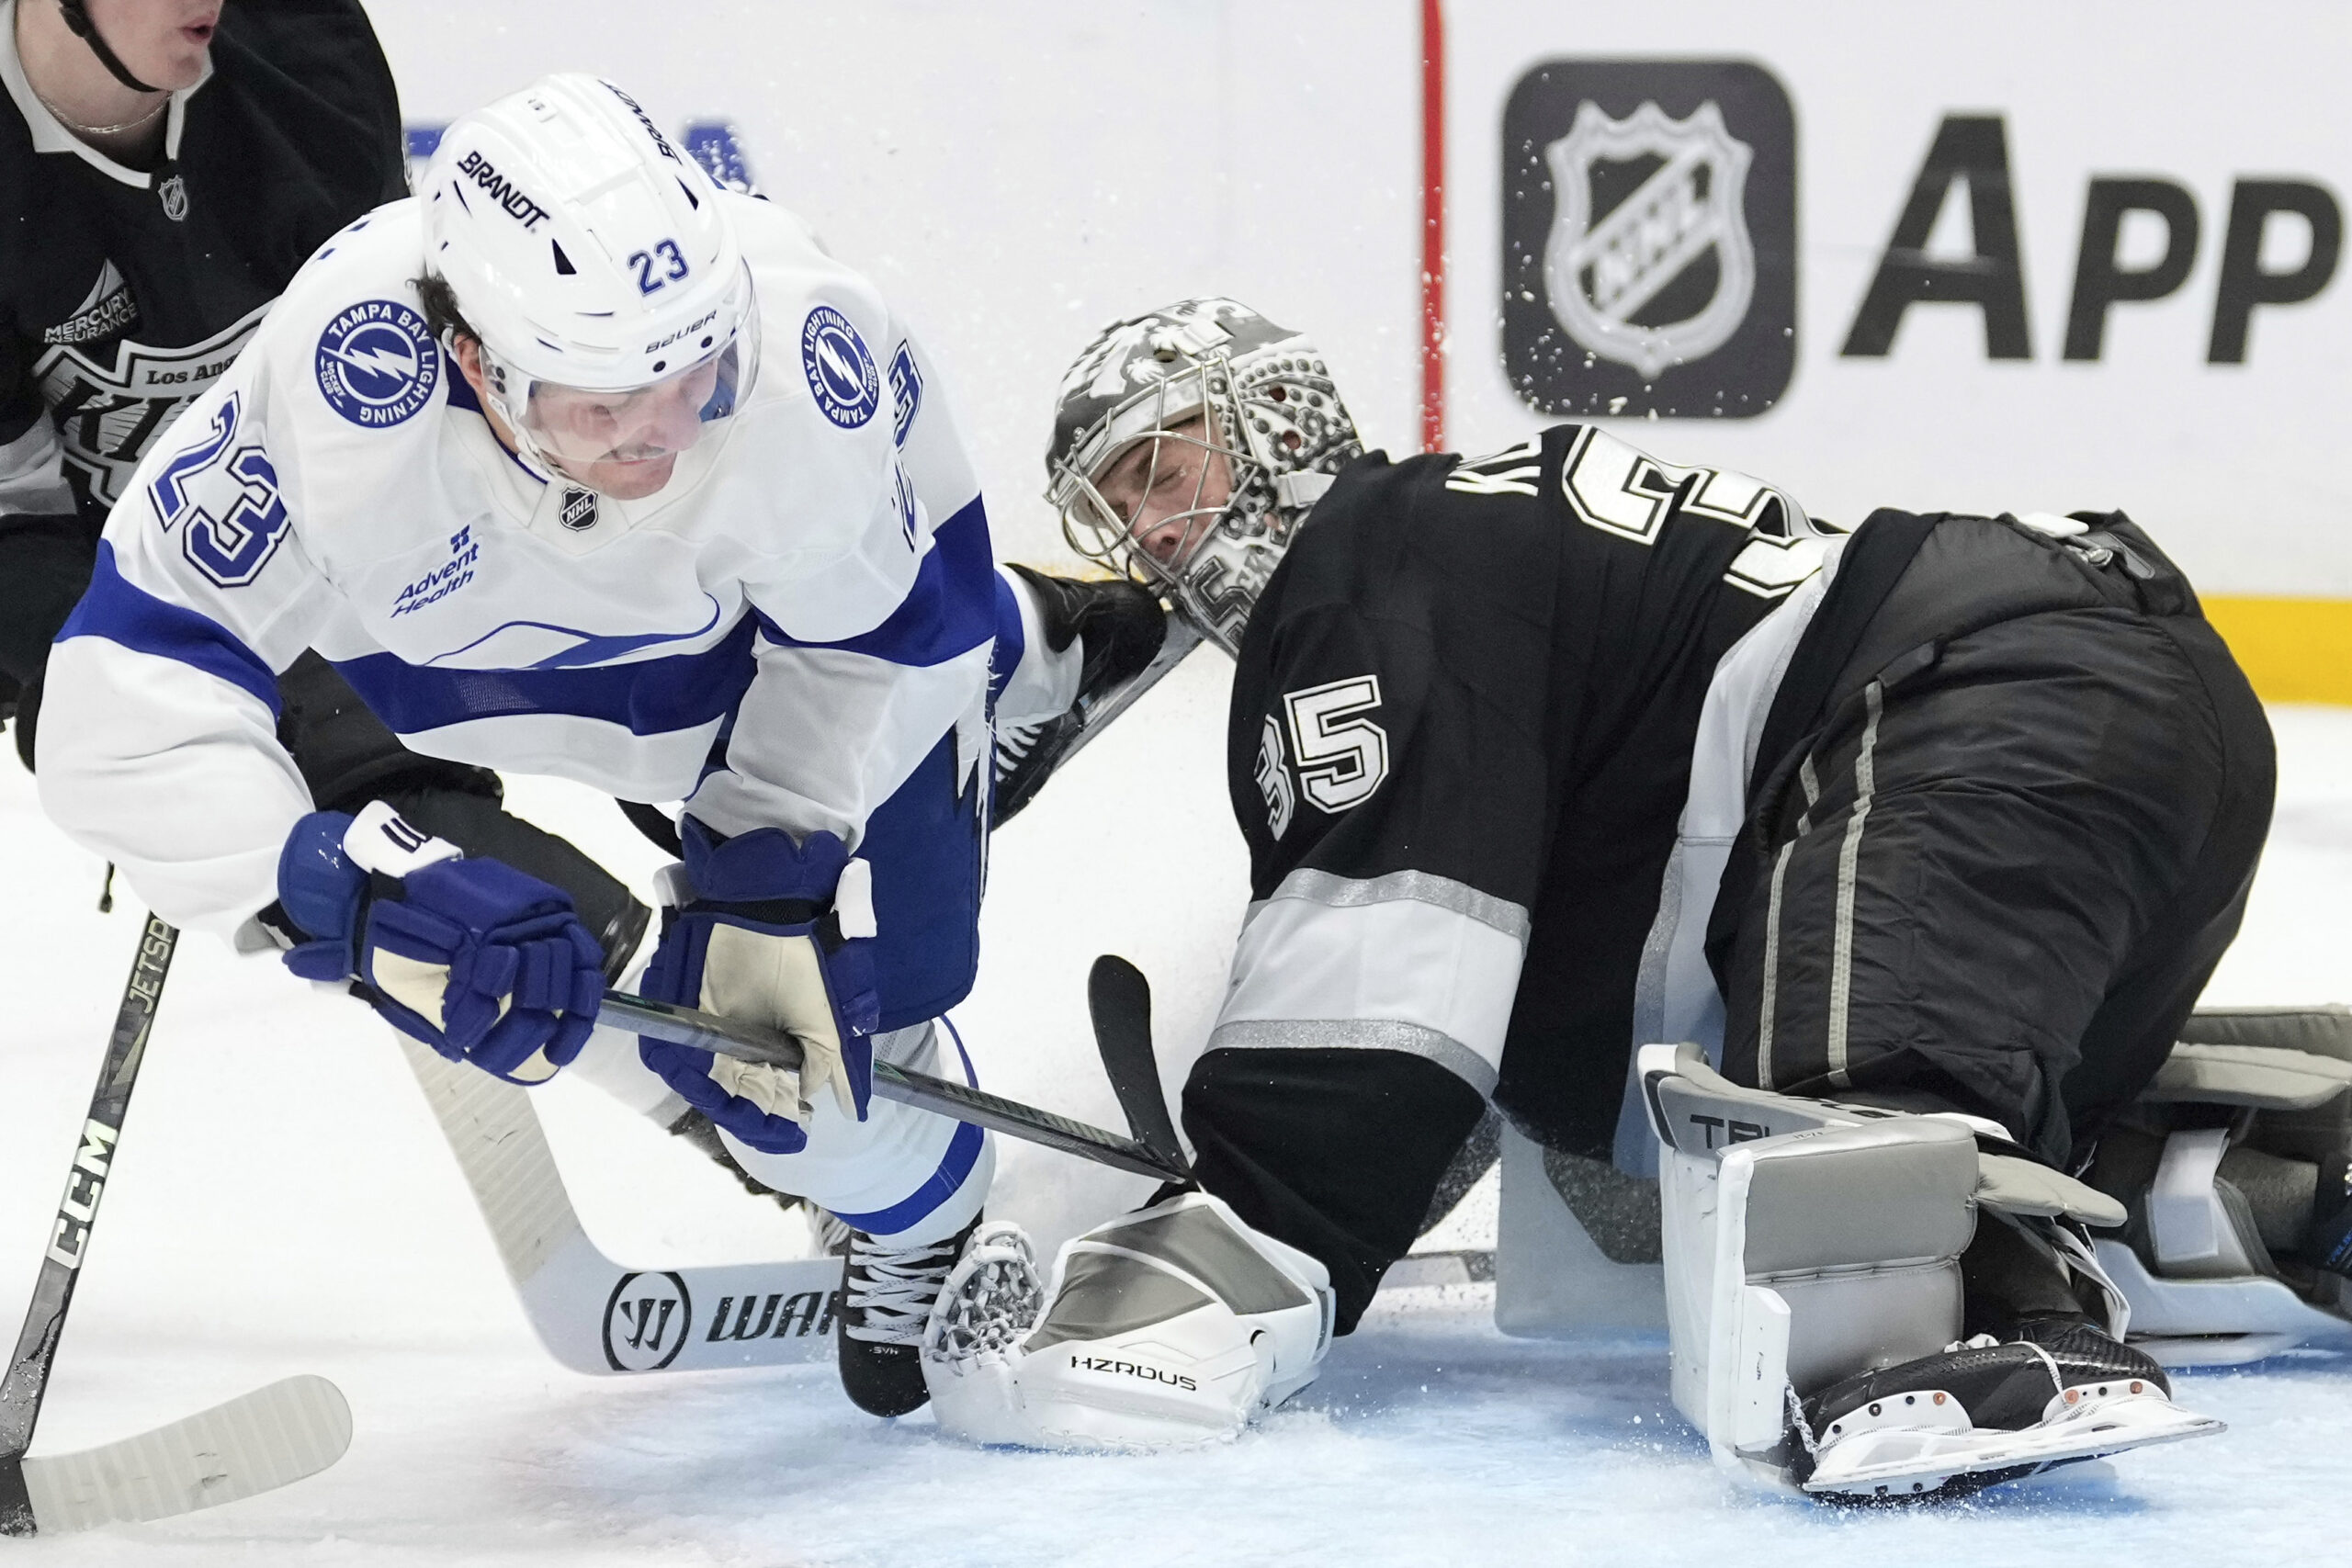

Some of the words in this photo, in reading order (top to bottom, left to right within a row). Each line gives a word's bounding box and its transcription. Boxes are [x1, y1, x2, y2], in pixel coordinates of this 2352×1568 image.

[457, 151, 550, 229] BRANDT
[627, 237, 690, 298] 23
[44, 304, 139, 344] INSURANCE
[45, 288, 130, 337] MERCURY
[328, 304, 391, 339] TAMPA
[397, 310, 431, 343] BAY
[805, 310, 855, 351] LIGHTNING
[359, 350, 435, 423] LIGHTNING
[807, 359, 825, 397] BAY
[824, 397, 868, 424] TAMPA
[148, 390, 291, 589] 23
[566, 497, 593, 524] NHL
[390, 570, 474, 618] Health
[394, 543, 480, 605] Advent
[1254, 674, 1390, 842] 35
[1690, 1113, 1770, 1148] TR
[46, 1117, 119, 1270] CCM
